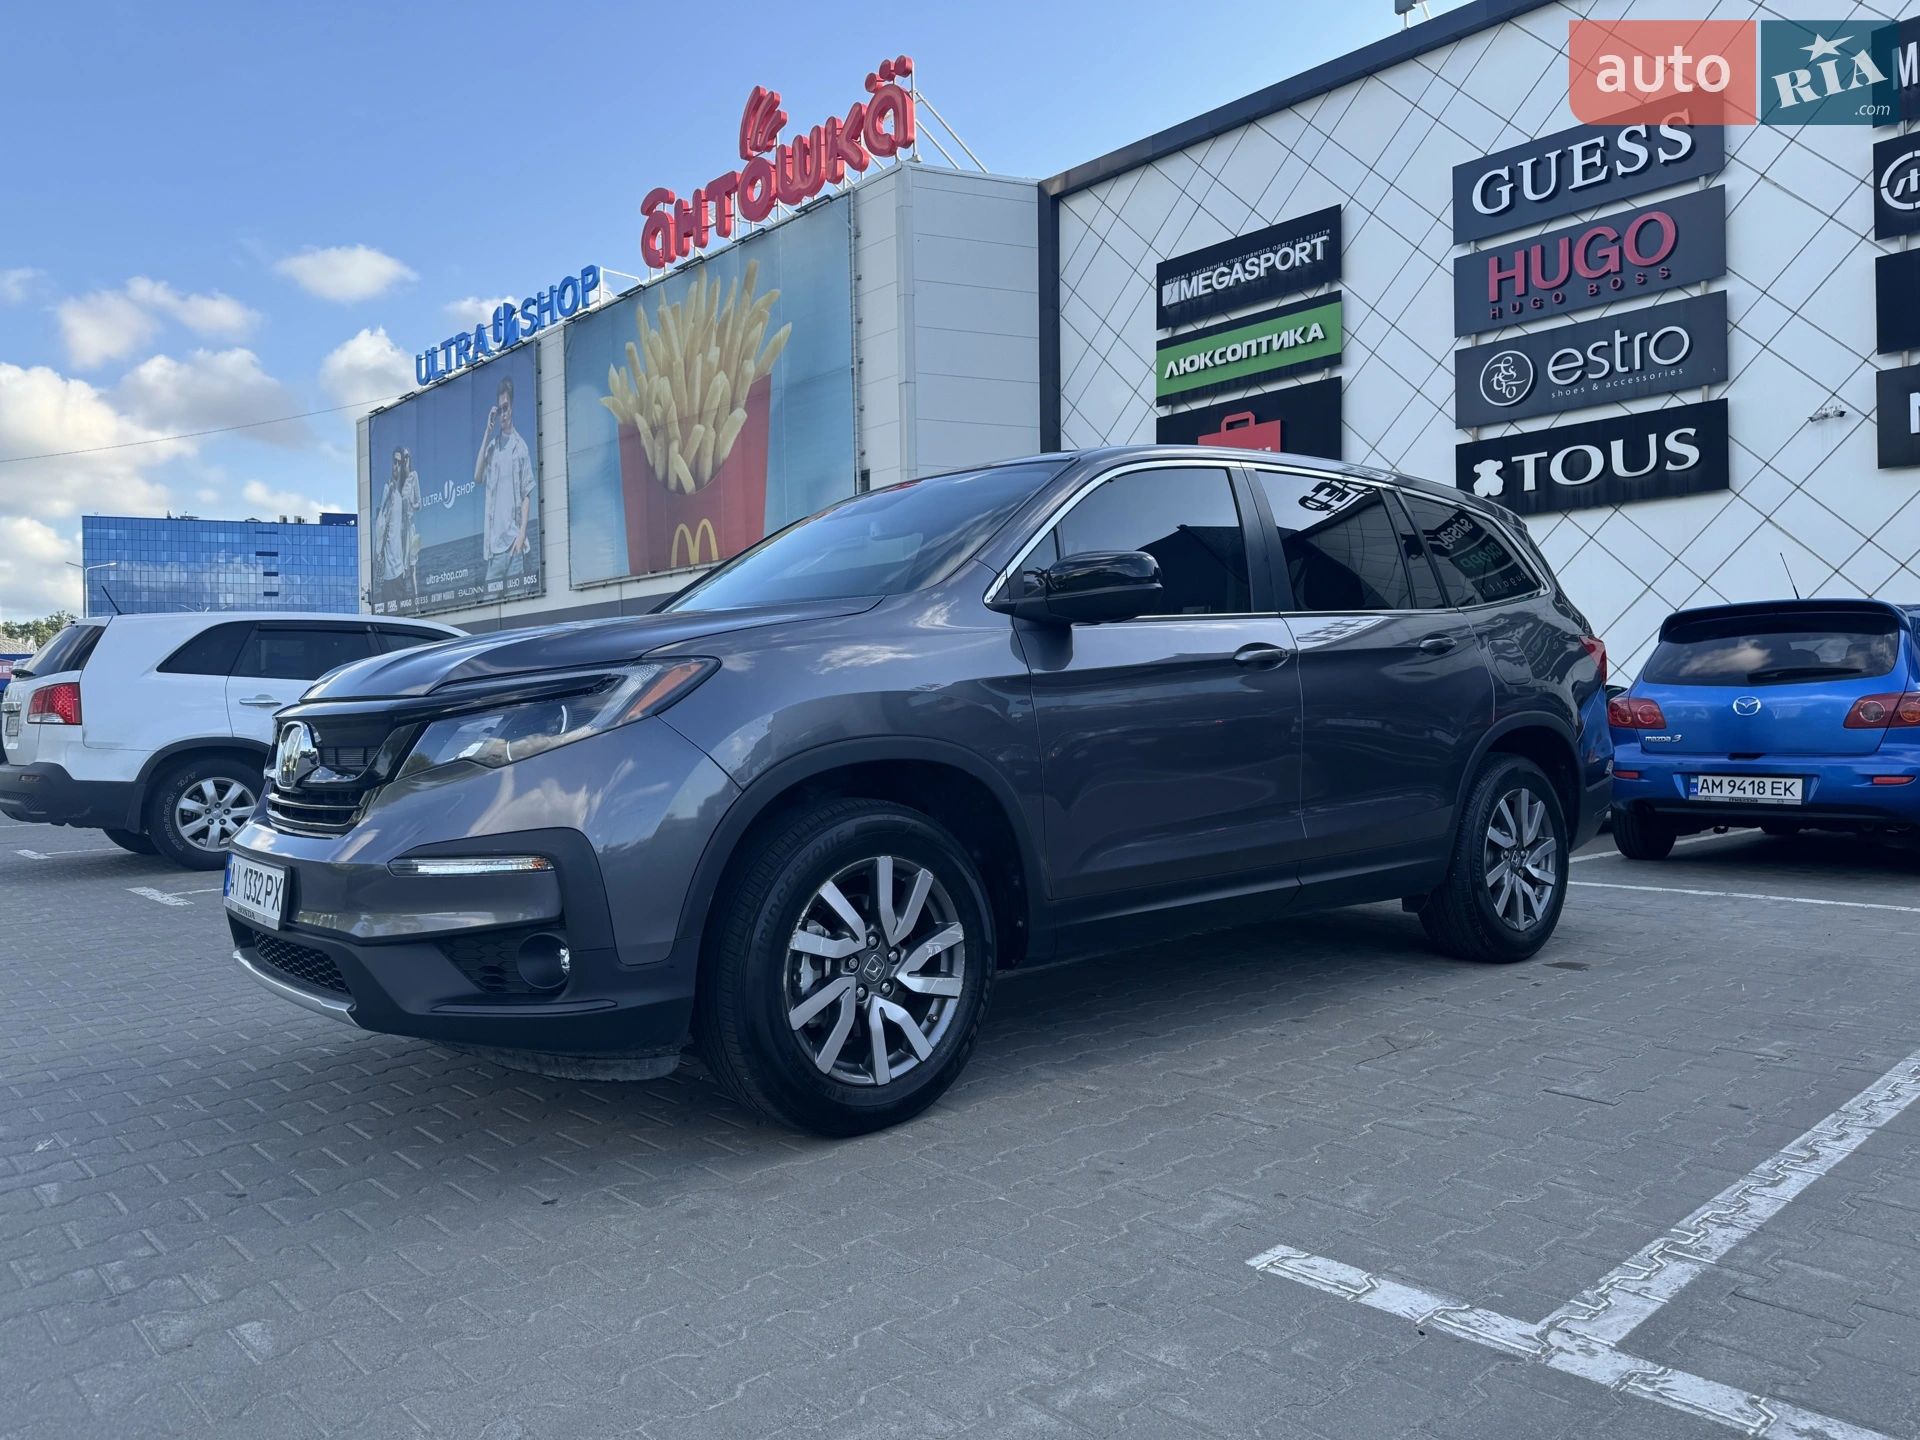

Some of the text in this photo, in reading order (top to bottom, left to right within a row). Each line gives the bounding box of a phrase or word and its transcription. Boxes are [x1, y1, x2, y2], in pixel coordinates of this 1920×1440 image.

[1472, 108, 1694, 216] GUESS
[1179, 235, 1330, 302] MEGASPORT
[1488, 211, 1677, 302] HUGO
[1490, 266, 1671, 319] HUGO BOSS
[415, 264, 601, 387] ULTRA SHOP
[1164, 322, 1326, 379] ЛЮКСОПТИКА
[1547, 325, 1691, 386] estro
[1551, 367, 1685, 399] shoes & accessories
[1511, 427, 1701, 493] TOUS
[422, 481, 475, 507] ULTRA SHOP
[425, 567, 469, 586] ultra-shop.com
[523, 574, 538, 586] BOSS
[1671, 733, 1683, 743] 3
[1699, 778, 1796, 797] AM 9418 EK
[237, 904, 256, 920] HONDA
[243, 866, 264, 906] 1332
[263, 873, 283, 913] PX
